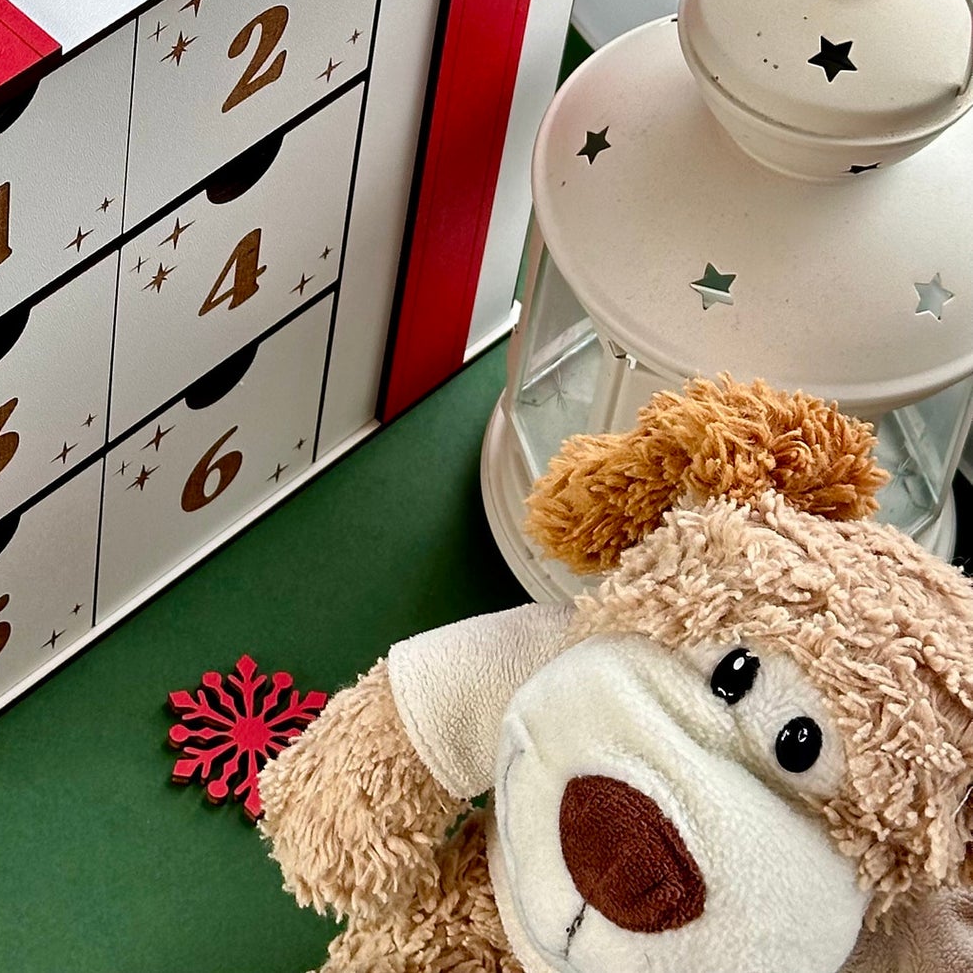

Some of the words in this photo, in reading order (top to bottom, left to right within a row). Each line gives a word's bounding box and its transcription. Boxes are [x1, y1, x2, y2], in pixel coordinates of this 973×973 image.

[222, 5, 289, 113] 2
[198, 228, 267, 317] 4
[180, 425, 243, 514] 6
